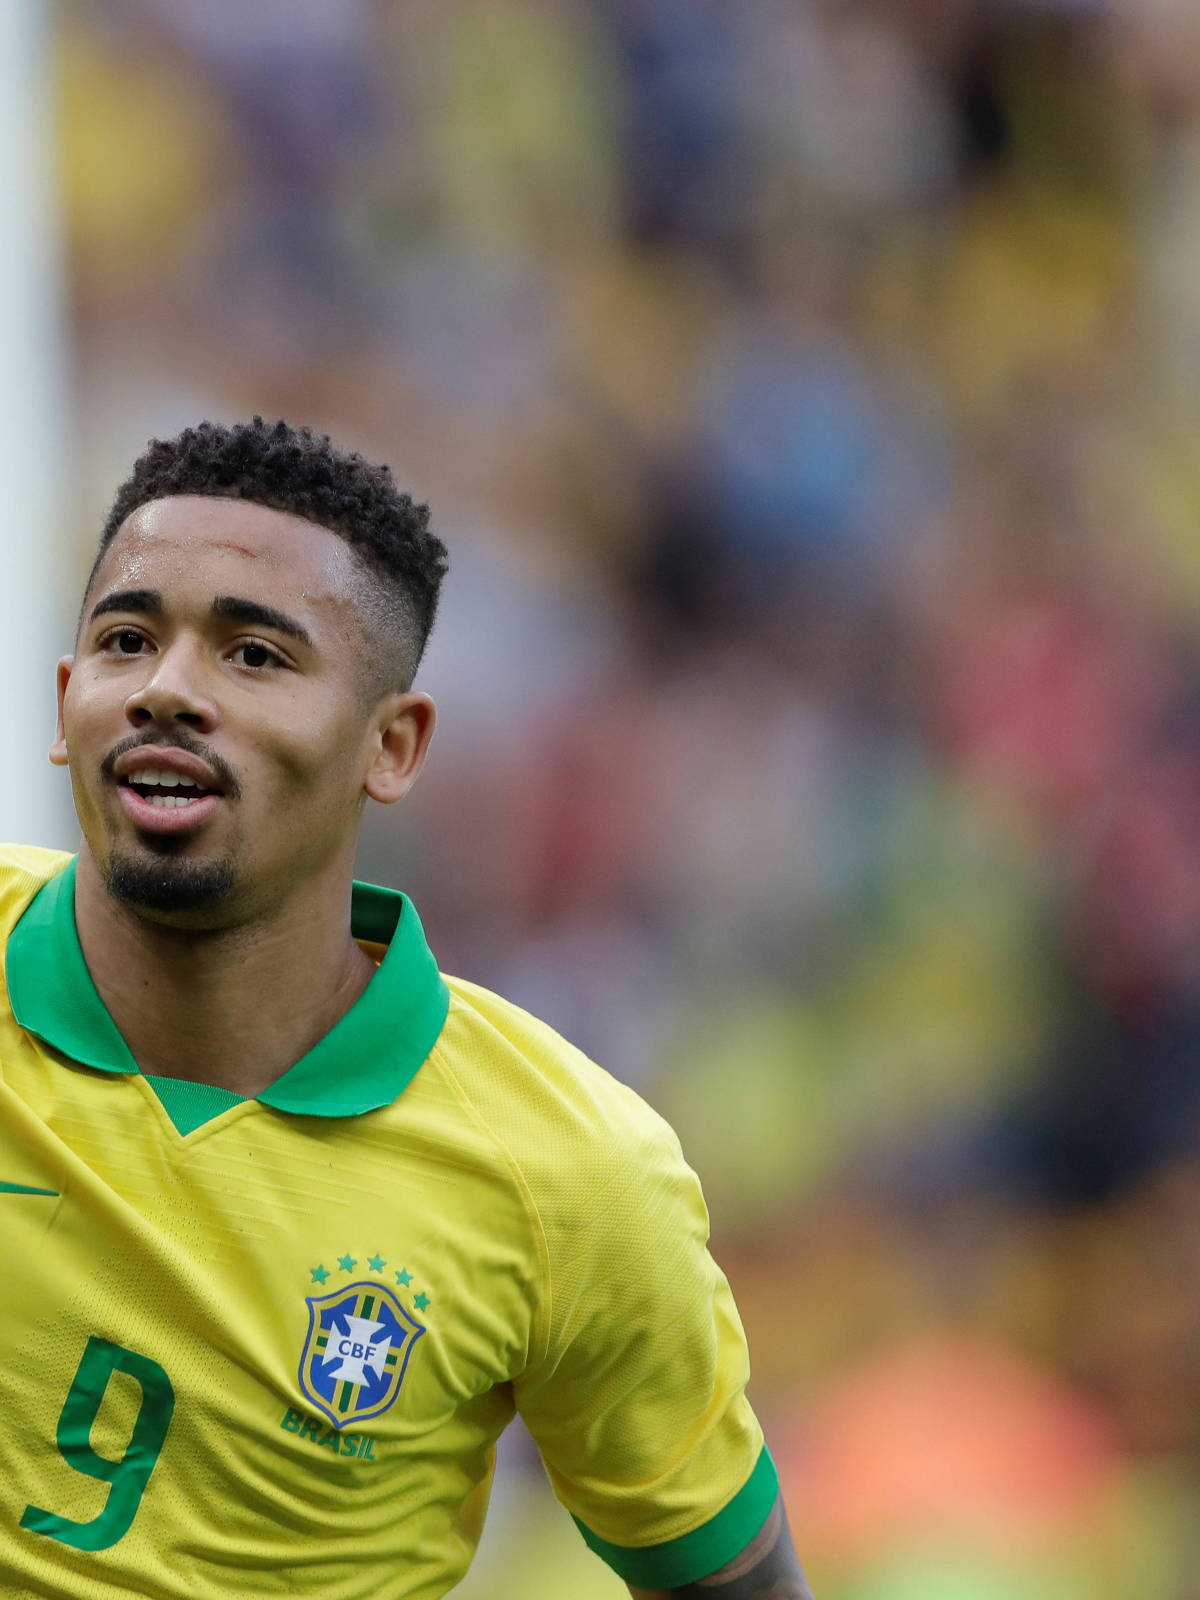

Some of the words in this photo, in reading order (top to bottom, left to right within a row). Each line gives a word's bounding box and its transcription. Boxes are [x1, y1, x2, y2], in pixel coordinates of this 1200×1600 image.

[338, 1340, 377, 1361] CBF
[19, 1335, 175, 1552] 9
[280, 1407, 377, 1460] BRASIL
